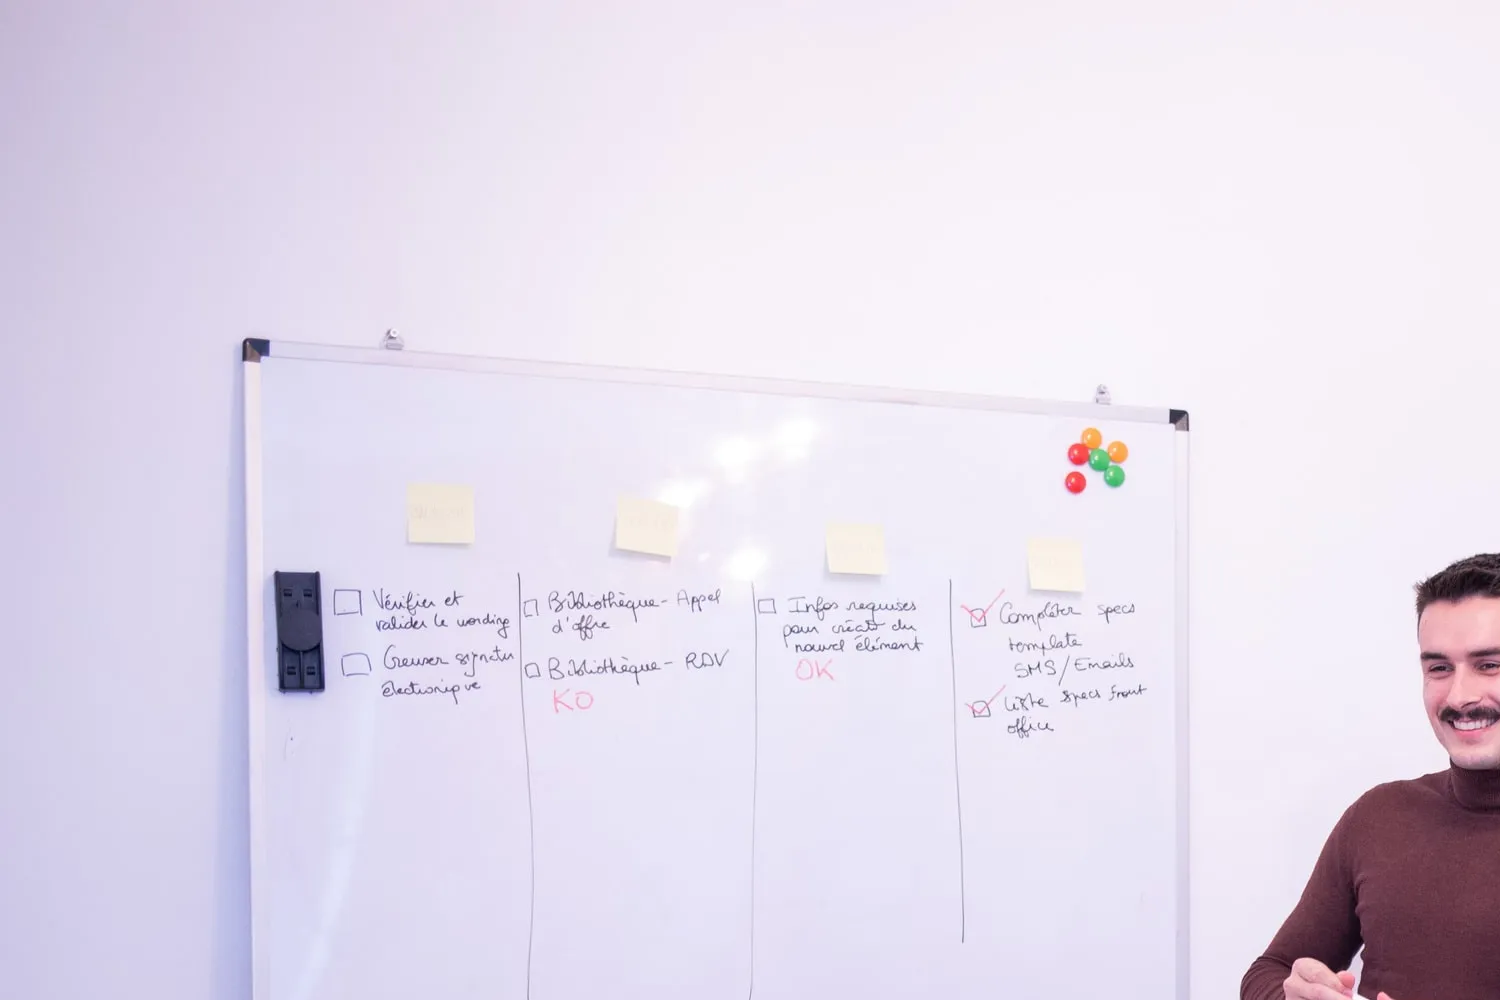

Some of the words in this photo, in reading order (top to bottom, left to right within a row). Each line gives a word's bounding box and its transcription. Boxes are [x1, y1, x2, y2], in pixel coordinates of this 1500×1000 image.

[373, 588, 435, 615] Vérifier
[444, 590, 464, 606] et
[677, 588, 721, 613] Appel
[787, 596, 839, 621] Infos
[846, 599, 917, 626] requises
[375, 614, 428, 632] valider
[434, 613, 448, 627] le
[457, 614, 510, 638] wording
[1098, 603, 1135, 624] specs
[552, 614, 611, 641] d'offre
[782, 623, 819, 648] pour
[891, 619, 917, 632] du
[795, 639, 845, 653] nouvel
[854, 635, 924, 652] élément
[1008, 632, 1083, 656] template
[685, 649, 730, 670] RDV
[795, 658, 835, 681] OK
[553, 688, 595, 713] KO
[1060, 689, 1101, 707] specs
[1108, 684, 1147, 701] front
[1007, 716, 1054, 738] office
